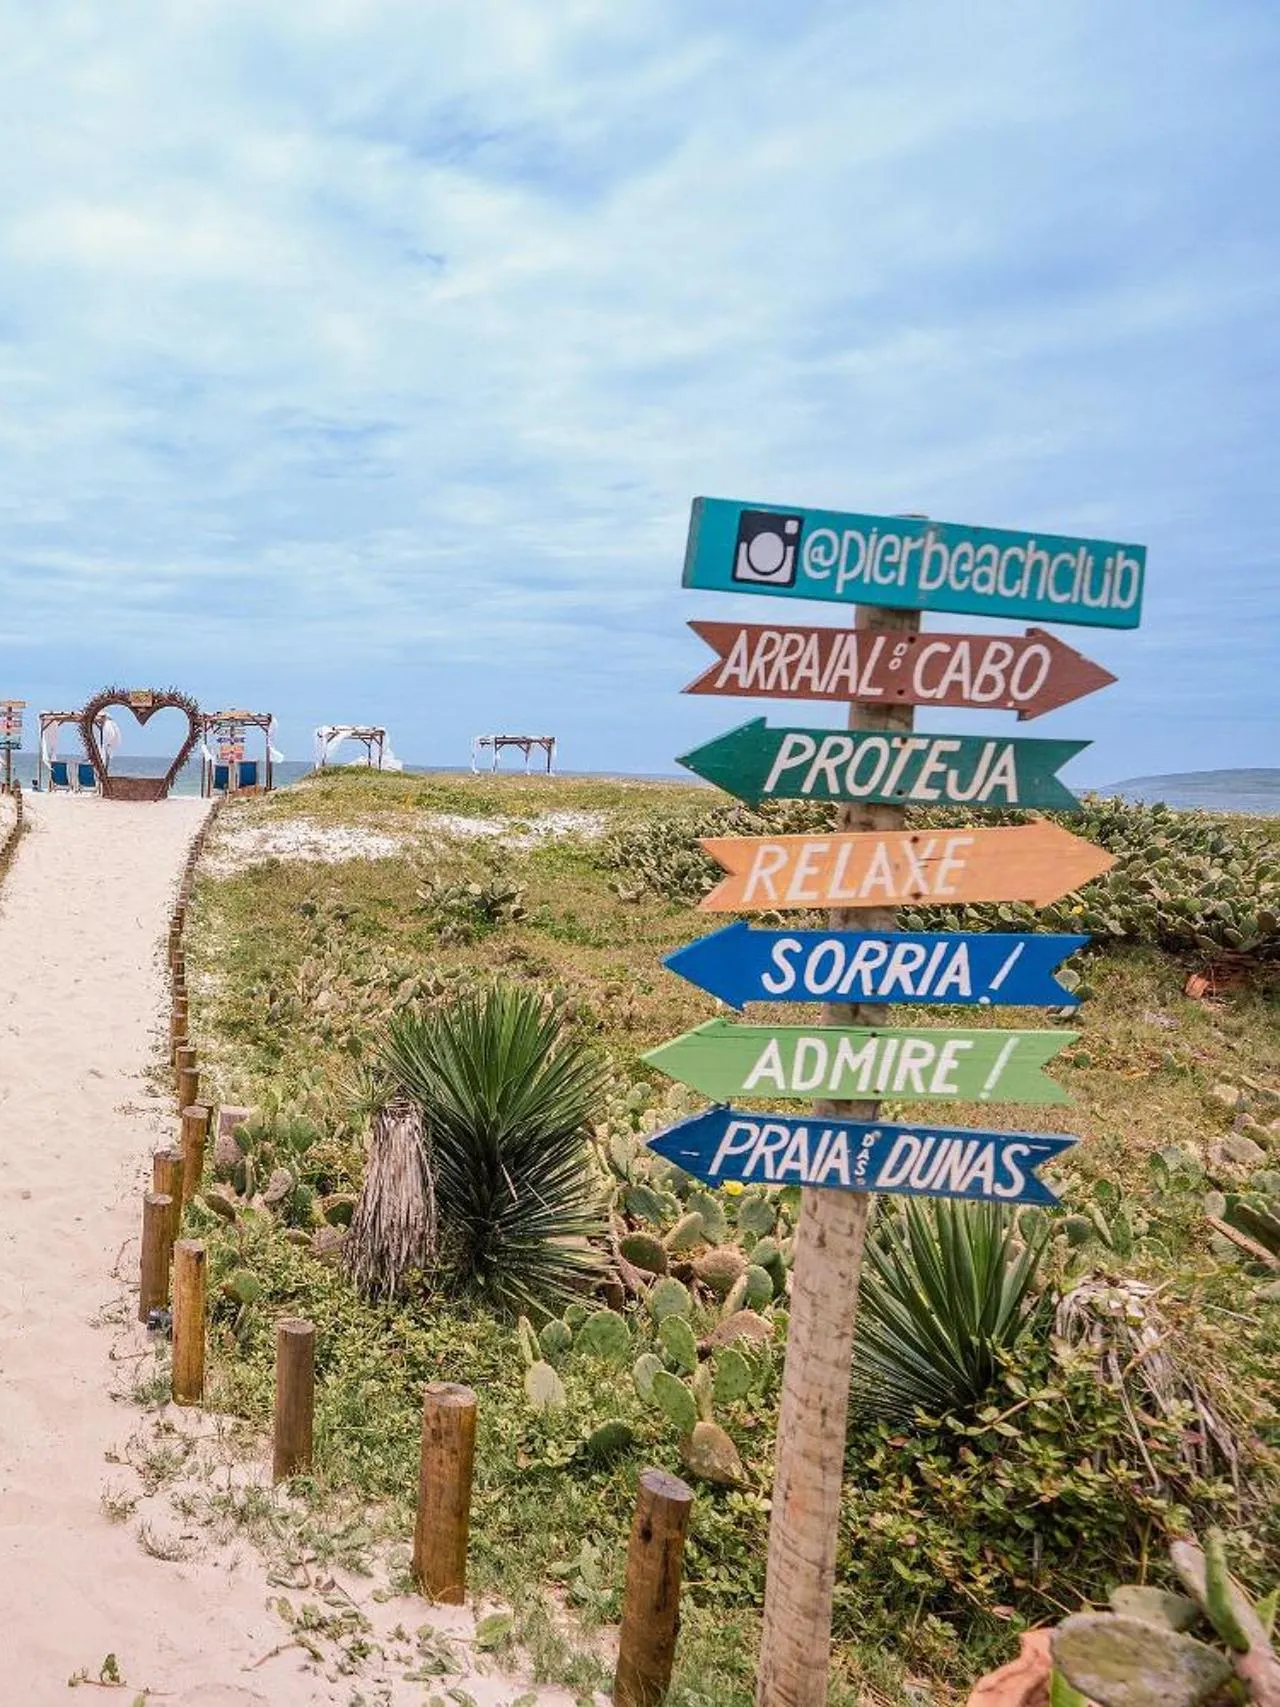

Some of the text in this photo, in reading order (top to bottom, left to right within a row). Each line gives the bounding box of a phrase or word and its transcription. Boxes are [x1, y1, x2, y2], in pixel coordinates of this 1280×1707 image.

[713, 629, 884, 696] ARRAIAL
[913, 641, 1052, 702] CABO
[763, 733, 1018, 804] PROTEJA
[742, 837, 975, 902] RELAXE
[708, 1120, 851, 1185] PRAIA
[875, 1134, 1031, 1199] DUNAS
